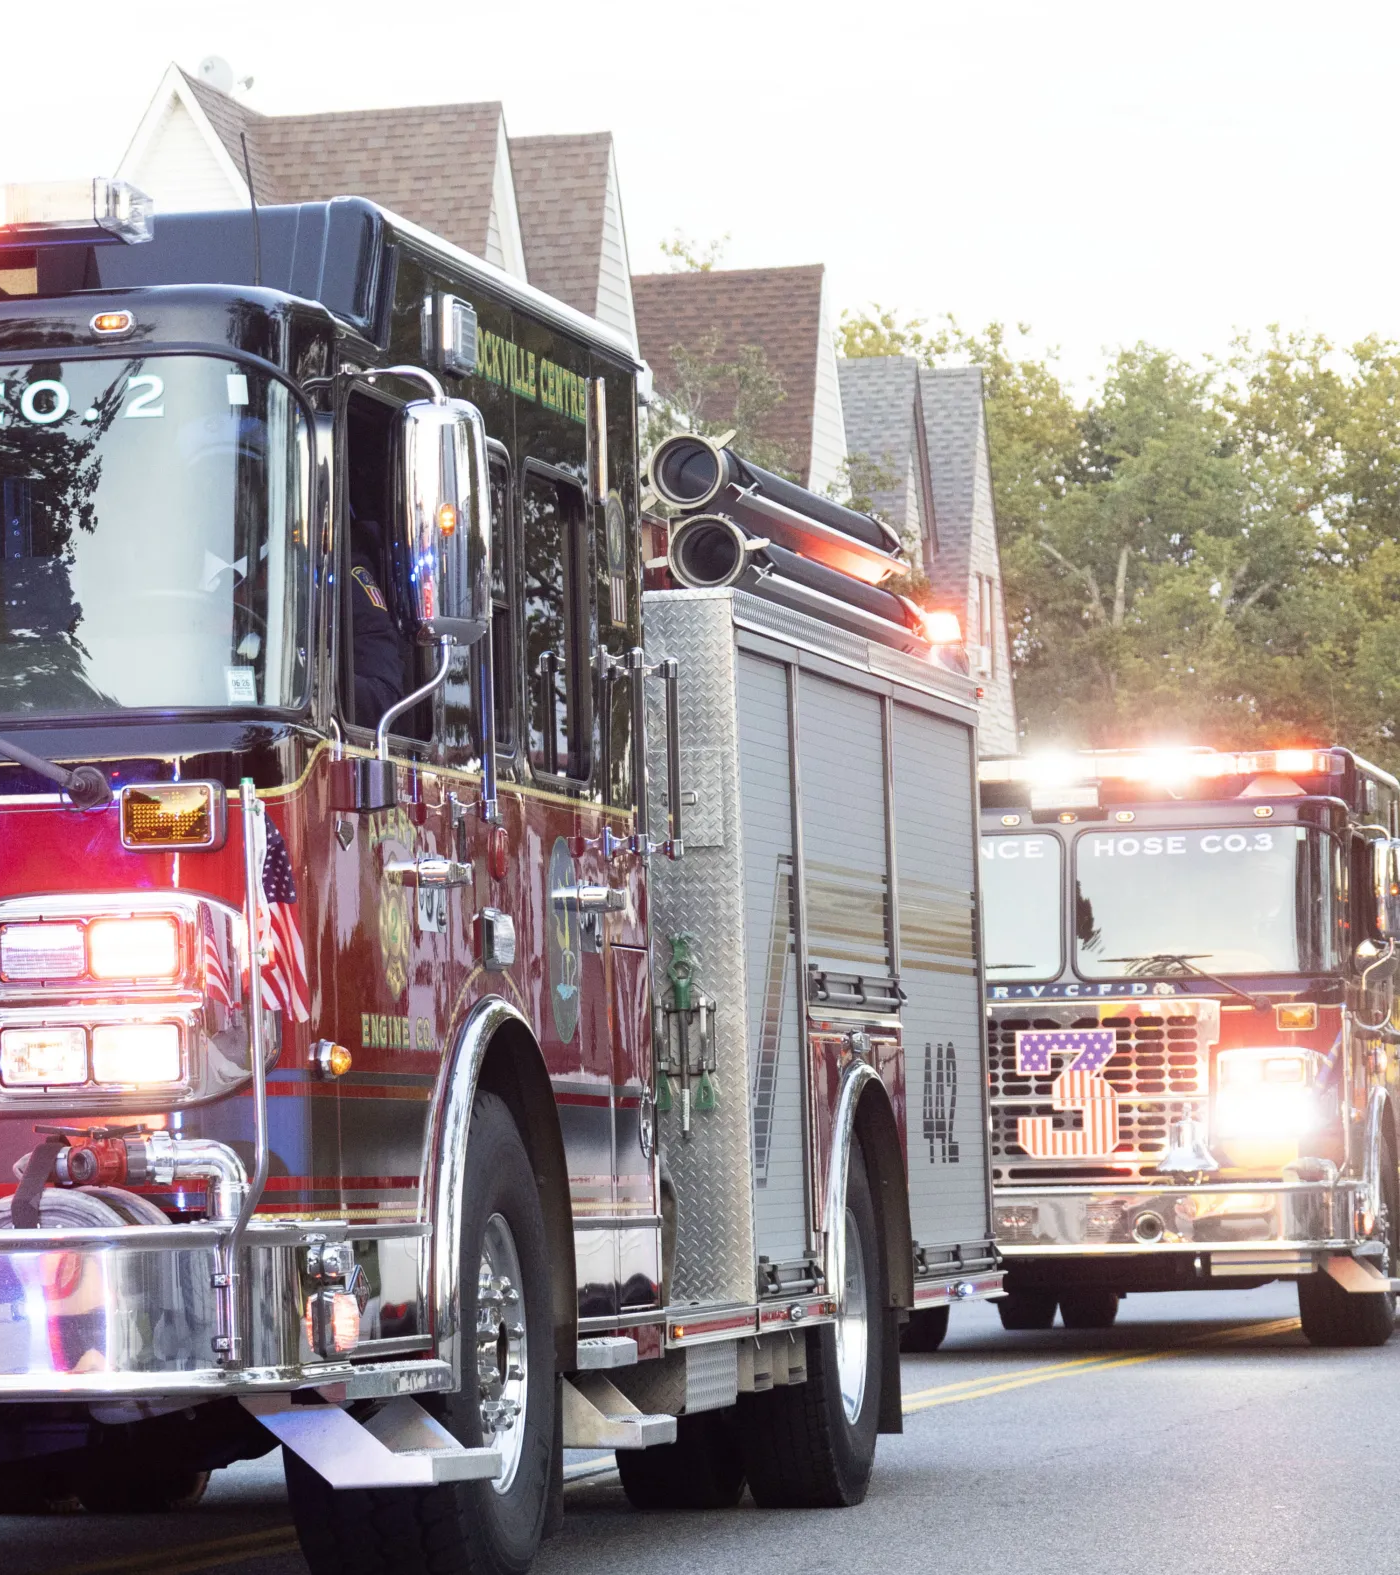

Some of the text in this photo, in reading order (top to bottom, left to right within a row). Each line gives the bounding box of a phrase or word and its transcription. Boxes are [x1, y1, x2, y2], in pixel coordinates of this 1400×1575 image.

[475, 326, 586, 424] OCKVILLE CENTRE
[123, 374, 166, 420] 2
[980, 840, 1044, 859] NCE
[1093, 836, 1186, 856] HOSE
[390, 908, 398, 943] 2
[361, 1013, 410, 1048] ENGINE
[1015, 1028, 1120, 1160] 3
